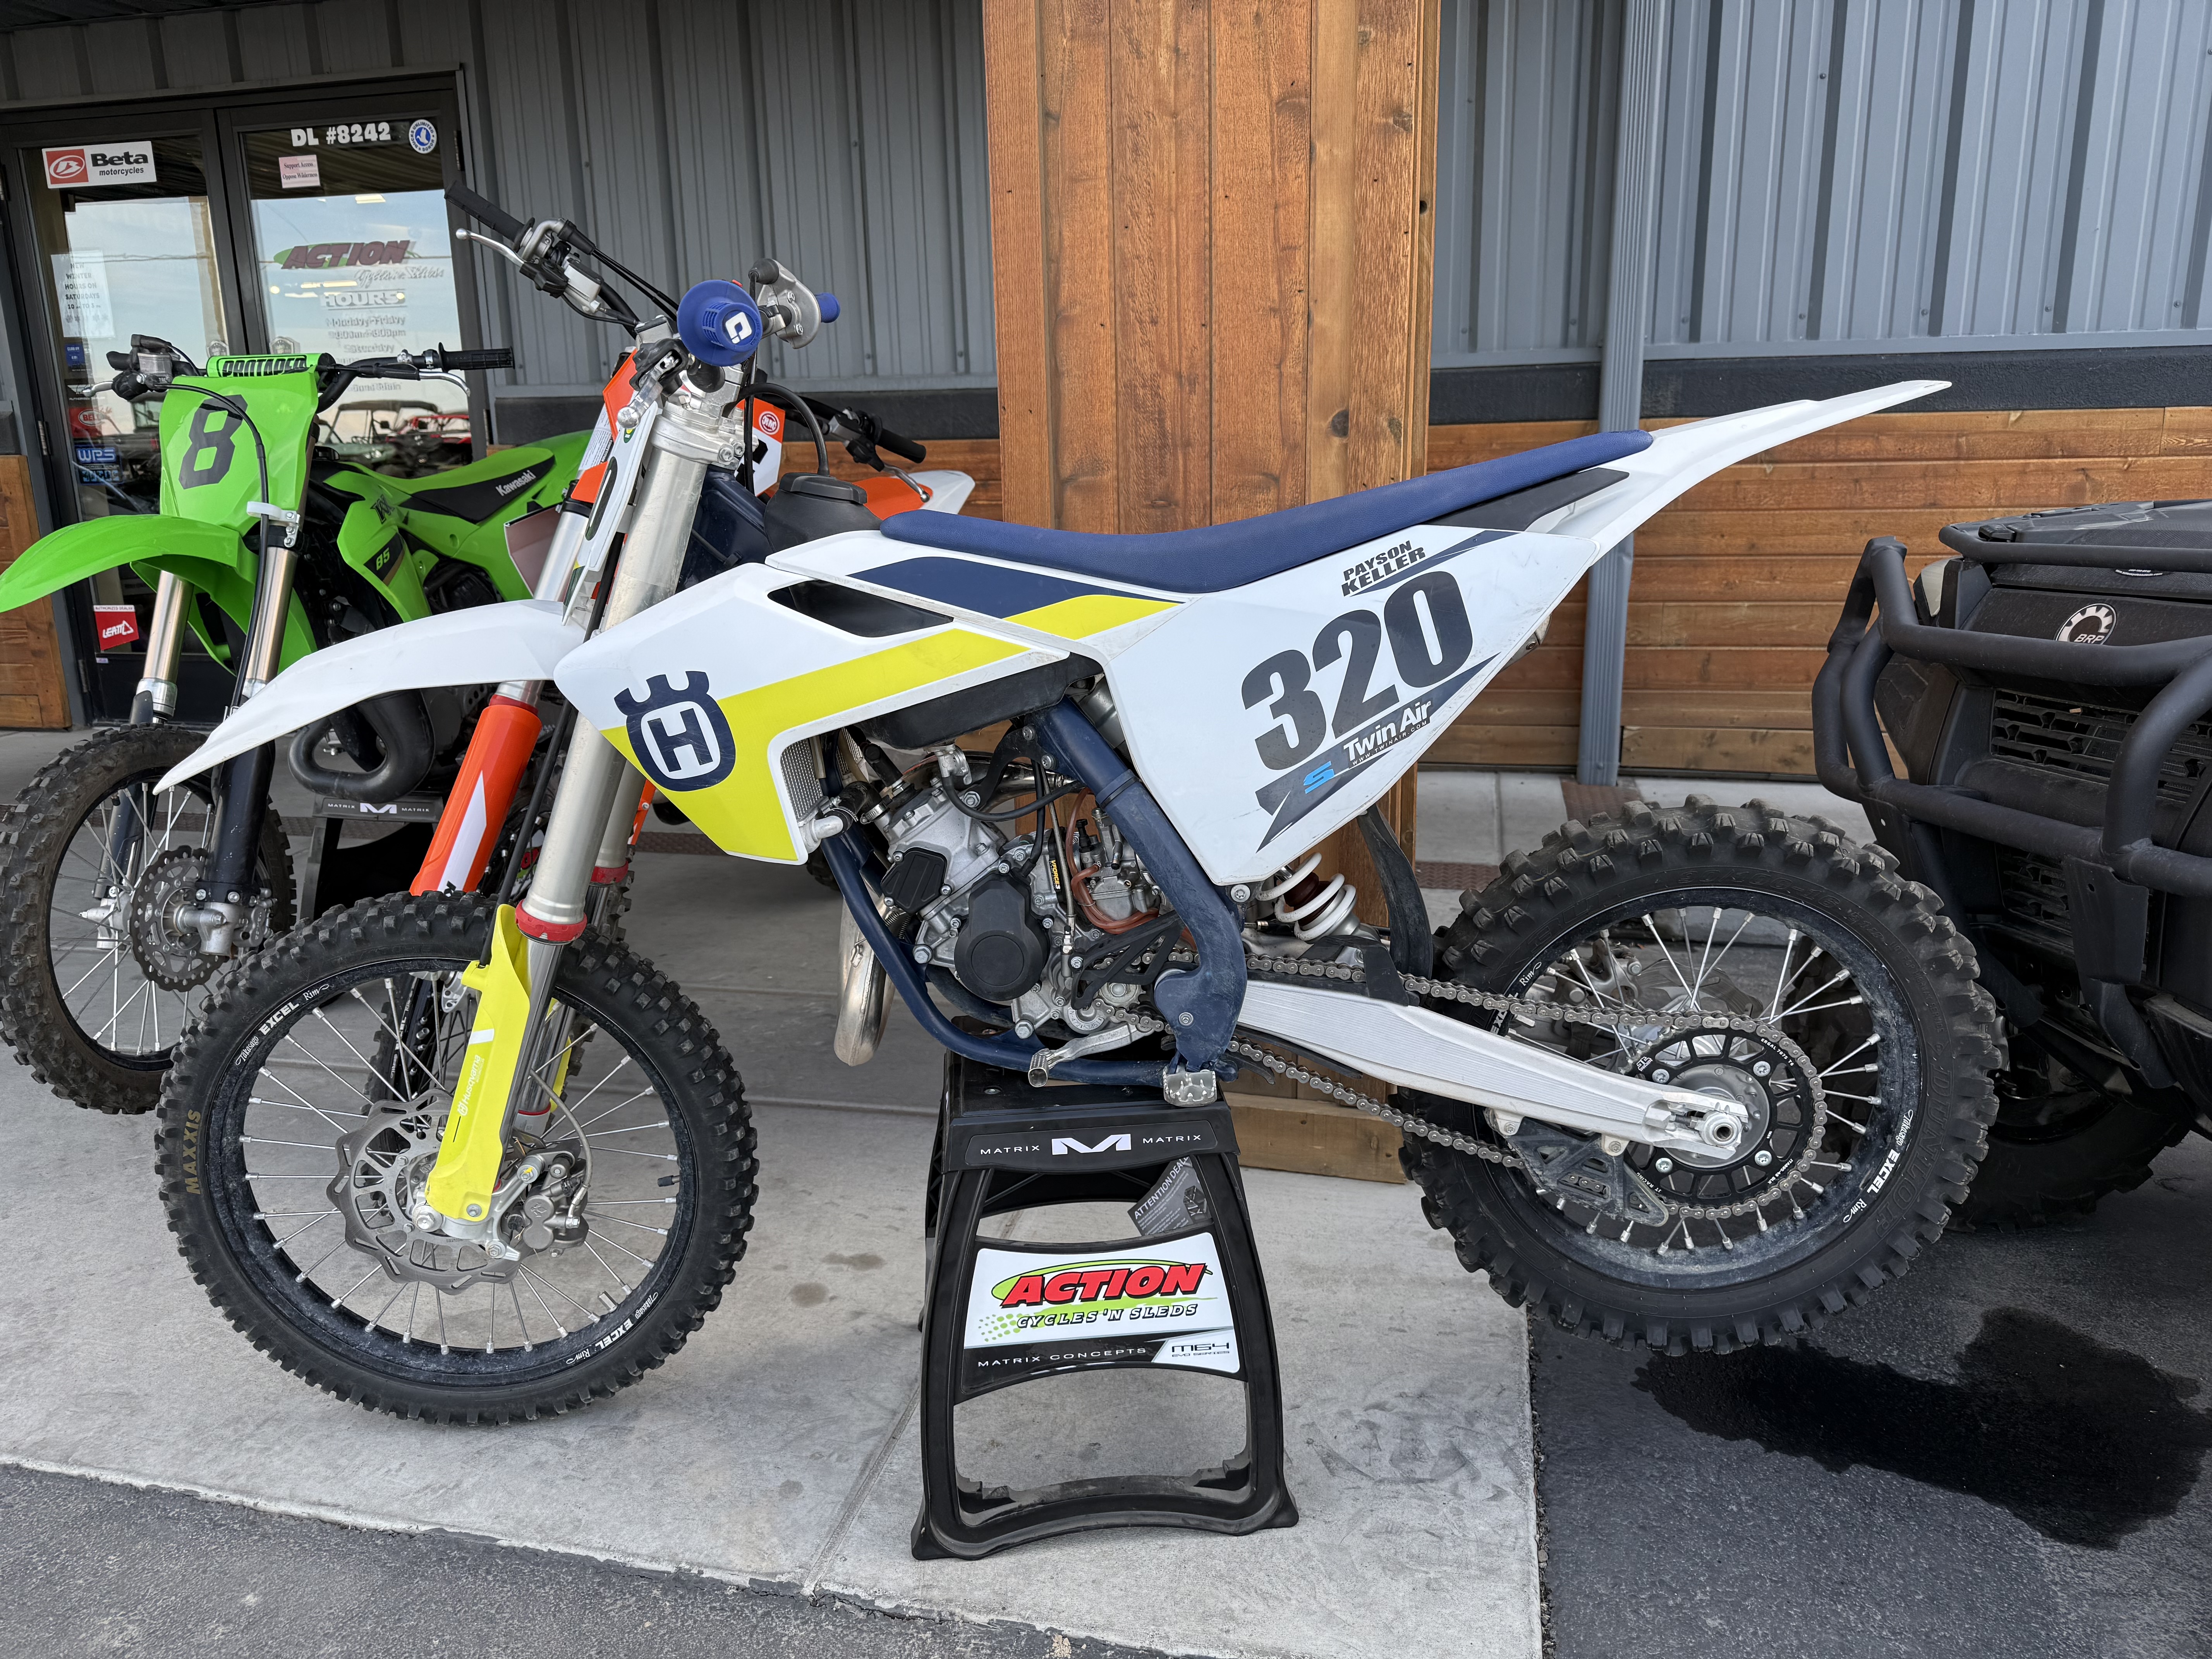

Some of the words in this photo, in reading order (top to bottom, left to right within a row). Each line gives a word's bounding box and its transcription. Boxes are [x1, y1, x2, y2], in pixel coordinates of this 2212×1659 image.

[291, 128, 319, 146] DL
[326, 122, 391, 144] #8242
[412, 122, 434, 133] UNLIMITED
[91, 151, 148, 167] Beta
[99, 167, 144, 176] motorcycles
[282, 240, 410, 269] ACTION
[322, 291, 405, 307] HOURS
[179, 394, 248, 489] 8
[78, 449, 115, 461] WPS
[495, 470, 536, 496] Kawasaki
[376, 547, 390, 570] 85
[1343, 540, 1412, 581] PAYSON
[1341, 547, 1425, 596] KELLER
[103, 623, 123, 638] LEATT
[2074, 634, 2105, 644] BRP
[1241, 571, 1473, 770] 320
[1343, 723, 1396, 761] Twin
[1400, 701, 1431, 732] Air
[1352, 720, 1426, 765] WWW.TWINAIR.COM
[1519, 962, 1542, 986] Rim
[235, 1036, 259, 1065] Takasago
[258, 1001, 299, 1035] EXCEL
[302, 984, 329, 1001] Rim
[1761, 1038, 1776, 1050] ERGAL
[462, 1054, 481, 1104] Husqvarna
[1895, 1109, 1913, 1146] Takasago
[183, 1109, 201, 1194] MAXXIS
[980, 1144, 1040, 1154] MATRIX
[1143, 1134, 1201, 1144] MATRIX
[1876, 1063, 1952, 1238] DUNLOP
[1637, 1172, 1654, 1188] RACING
[1867, 1149, 1900, 1194] EXCEL
[1134, 1176, 1173, 1219] ATTENTION
[1843, 1198, 1867, 1223] Rim
[1001, 1263, 1206, 1308] ACTION
[635, 1292, 658, 1319] Takasago
[1017, 1311, 1098, 1328] CYCLES
[1130, 1304, 1198, 1320] SLEDS
[595, 1319, 634, 1349] EXCEL
[566, 1348, 590, 1364] Rim
[978, 1356, 1041, 1368] MATRIX
[1047, 1348, 1146, 1360] CONCEPTS
[1172, 1343, 1229, 1352] M64
